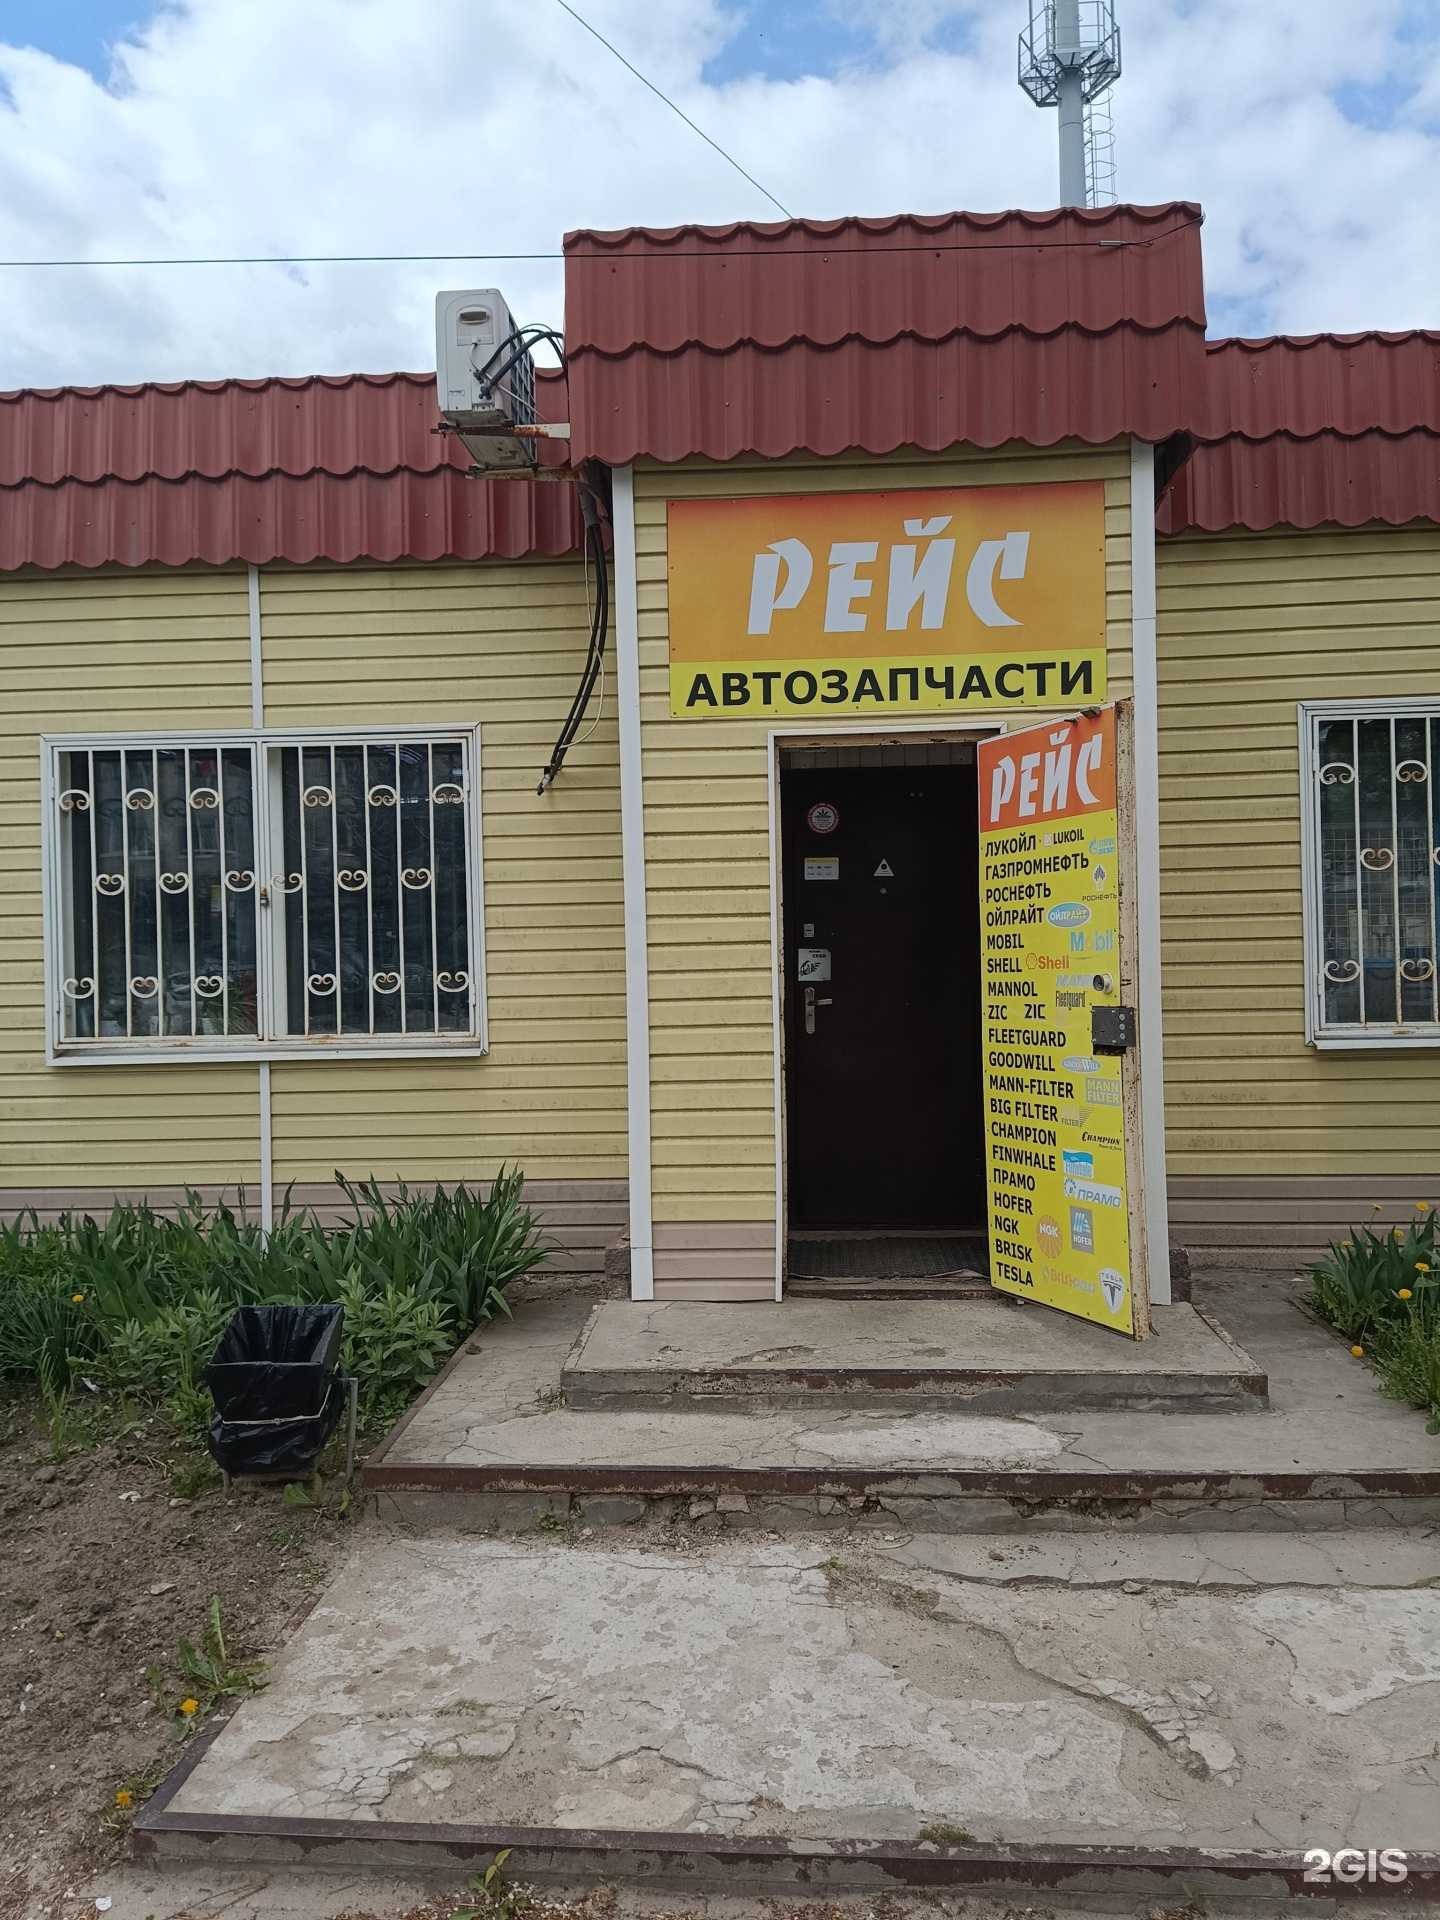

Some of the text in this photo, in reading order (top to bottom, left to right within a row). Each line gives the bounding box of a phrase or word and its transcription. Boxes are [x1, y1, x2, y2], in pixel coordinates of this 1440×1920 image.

[746, 515, 1031, 635] РЕЙС
[685, 660, 1093, 707] АВТОЗАПЧАСТИ
[990, 727, 1103, 823] РЕЙС
[985, 832, 1036, 857] ЛУКОЙЛ
[1053, 828, 1085, 845] LUKOIL
[985, 852, 1089, 880] ГАЗПРОМНЕФТЬ
[986, 882, 1051, 903] РОСНЕФТЬ
[986, 904, 1045, 927] ОЙЛРАЙТ
[987, 934, 1024, 950] MOBIL
[987, 957, 1022, 973] SHELL
[1038, 955, 1069, 969] Shell
[988, 981, 1038, 996] MANNOL
[988, 1005, 1007, 1020] ZIC
[1024, 1004, 1046, 1019] ZIC
[988, 1028, 1066, 1047] FLEETGUARD
[989, 1052, 1055, 1072] GOODWILL
[989, 1075, 1074, 1099] MANN-FILTER
[1087, 1078, 1120, 1091] MANN
[1087, 1091, 1121, 1105] FILTER
[990, 1098, 1011, 1115] BIG
[1015, 1101, 1058, 1122] FILTER
[991, 1121, 1057, 1146] CHAMPION
[992, 1145, 1056, 1172] FINWHALE
[993, 1168, 1036, 1191] ПРАМО
[994, 1192, 1033, 1215] HOFER
[1077, 1189, 1121, 1208] ПРАМО
[995, 1215, 1019, 1236] NGK
[1039, 1223, 1058, 1237] NGK
[995, 1239, 1033, 1263] BRISK
[1073, 1235, 1092, 1246] HOFER
[996, 1262, 1033, 1287] TESLA
